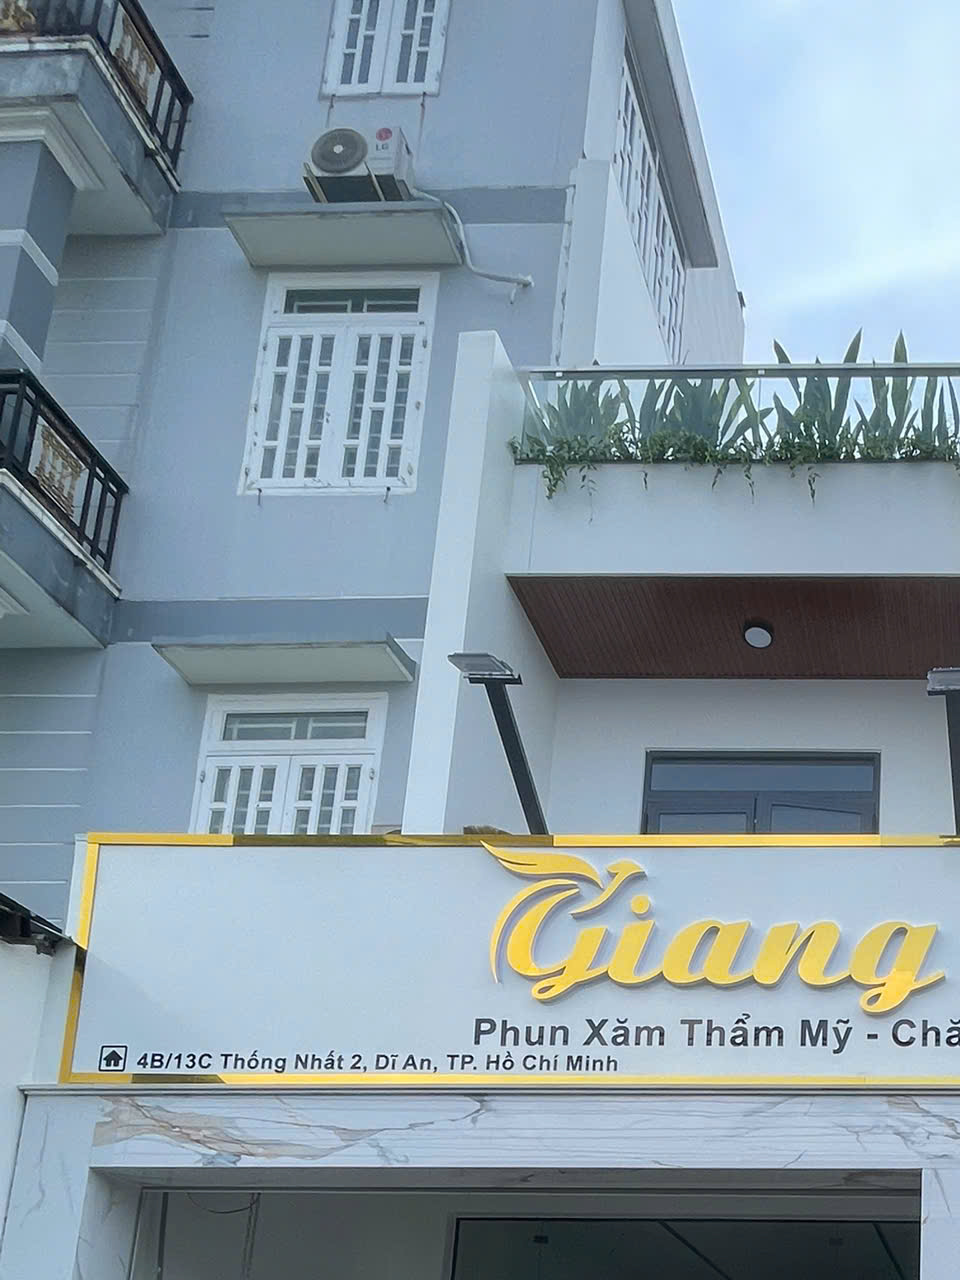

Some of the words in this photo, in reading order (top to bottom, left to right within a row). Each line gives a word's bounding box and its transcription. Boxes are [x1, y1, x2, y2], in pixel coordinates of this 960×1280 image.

[375, 143, 389, 151] LG
[481, 841, 946, 1016] Giang
[473, 1017, 570, 1046] Phun
[582, 1017, 665, 1047] Xăm
[680, 1013, 785, 1047] Thẩm
[800, 1017, 853, 1054] Mỹ
[136, 1052, 213, 1069] 4B/13C
[220, 1050, 287, 1073] Thống
[294, 1050, 344, 1070] Nhất
[350, 1053, 368, 1072] 2,
[375, 1053, 398, 1070] Dĩ
[402, 1054, 438, 1073] An,
[447, 1054, 477, 1071] TP.
[486, 1051, 514, 1071] Hồ
[522, 1053, 558, 1071] Chí
[566, 1054, 618, 1072] Minh
